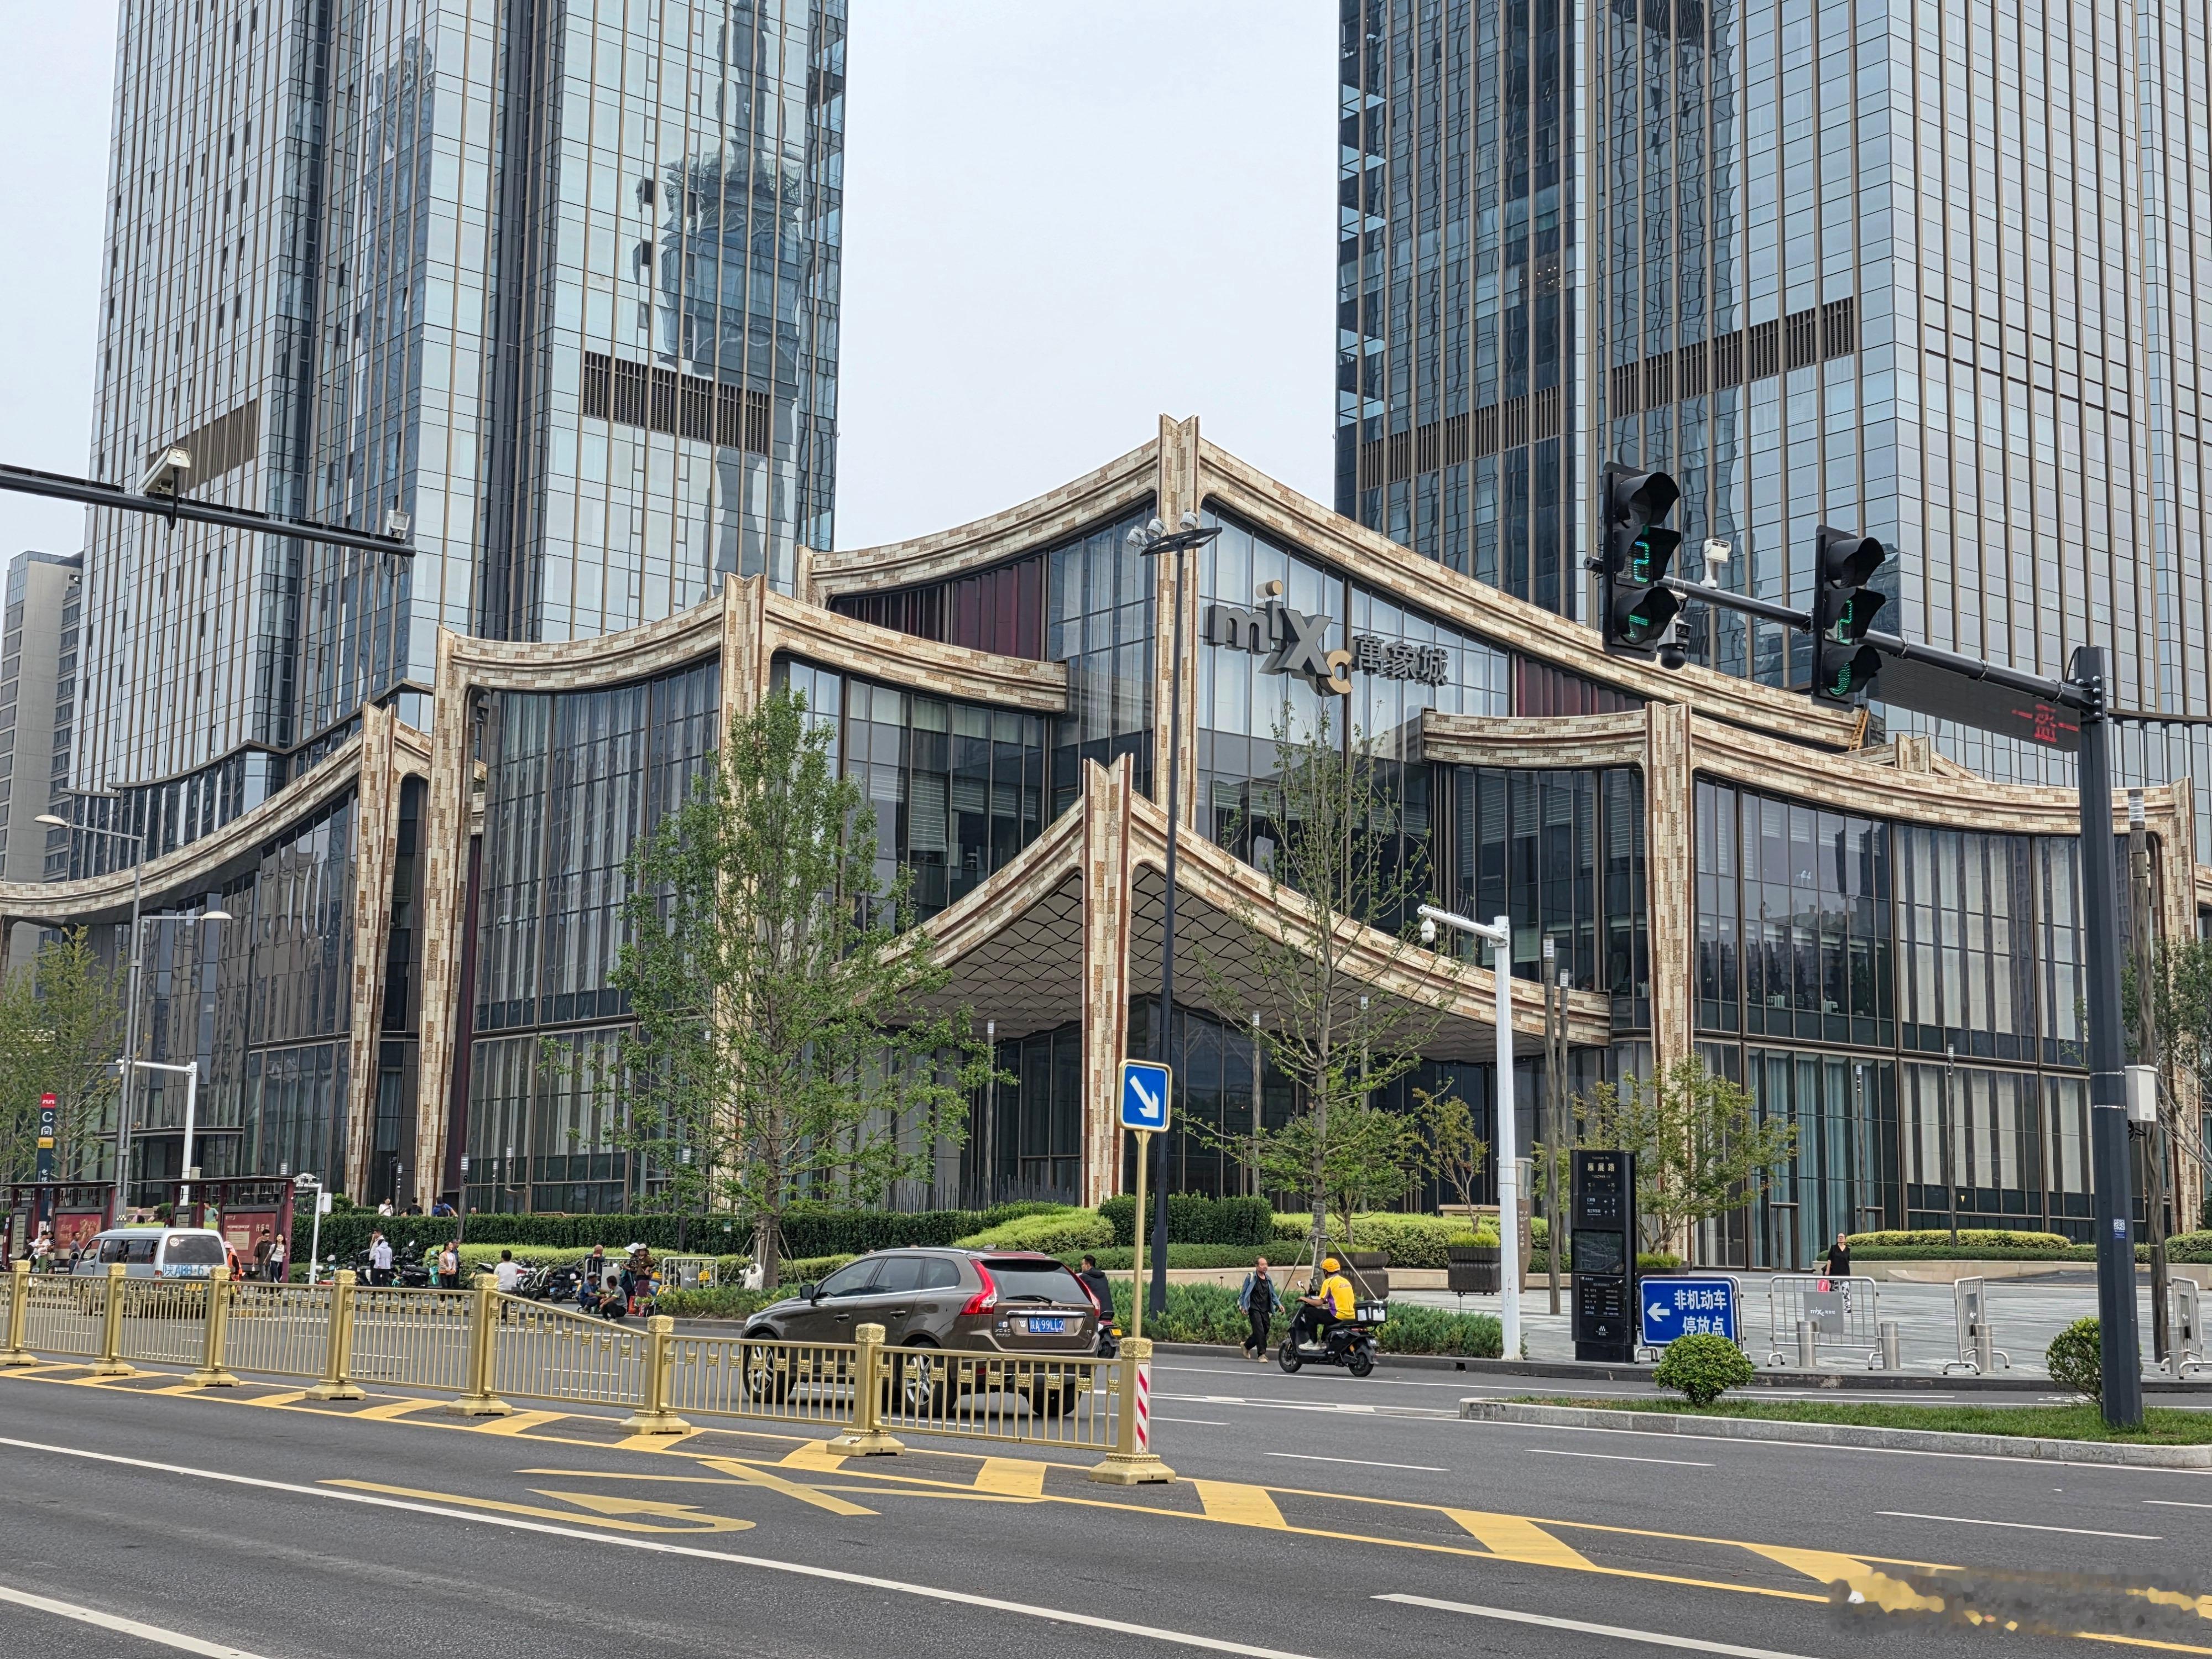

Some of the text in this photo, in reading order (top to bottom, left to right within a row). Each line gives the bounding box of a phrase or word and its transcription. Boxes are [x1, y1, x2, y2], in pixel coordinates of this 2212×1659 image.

[1353, 635, 1448, 687] 萬象城
[42, 1112, 53, 1122] C
[1674, 1289, 1727, 1311] 非机动车
[1682, 1316, 1725, 1336] 停放点
